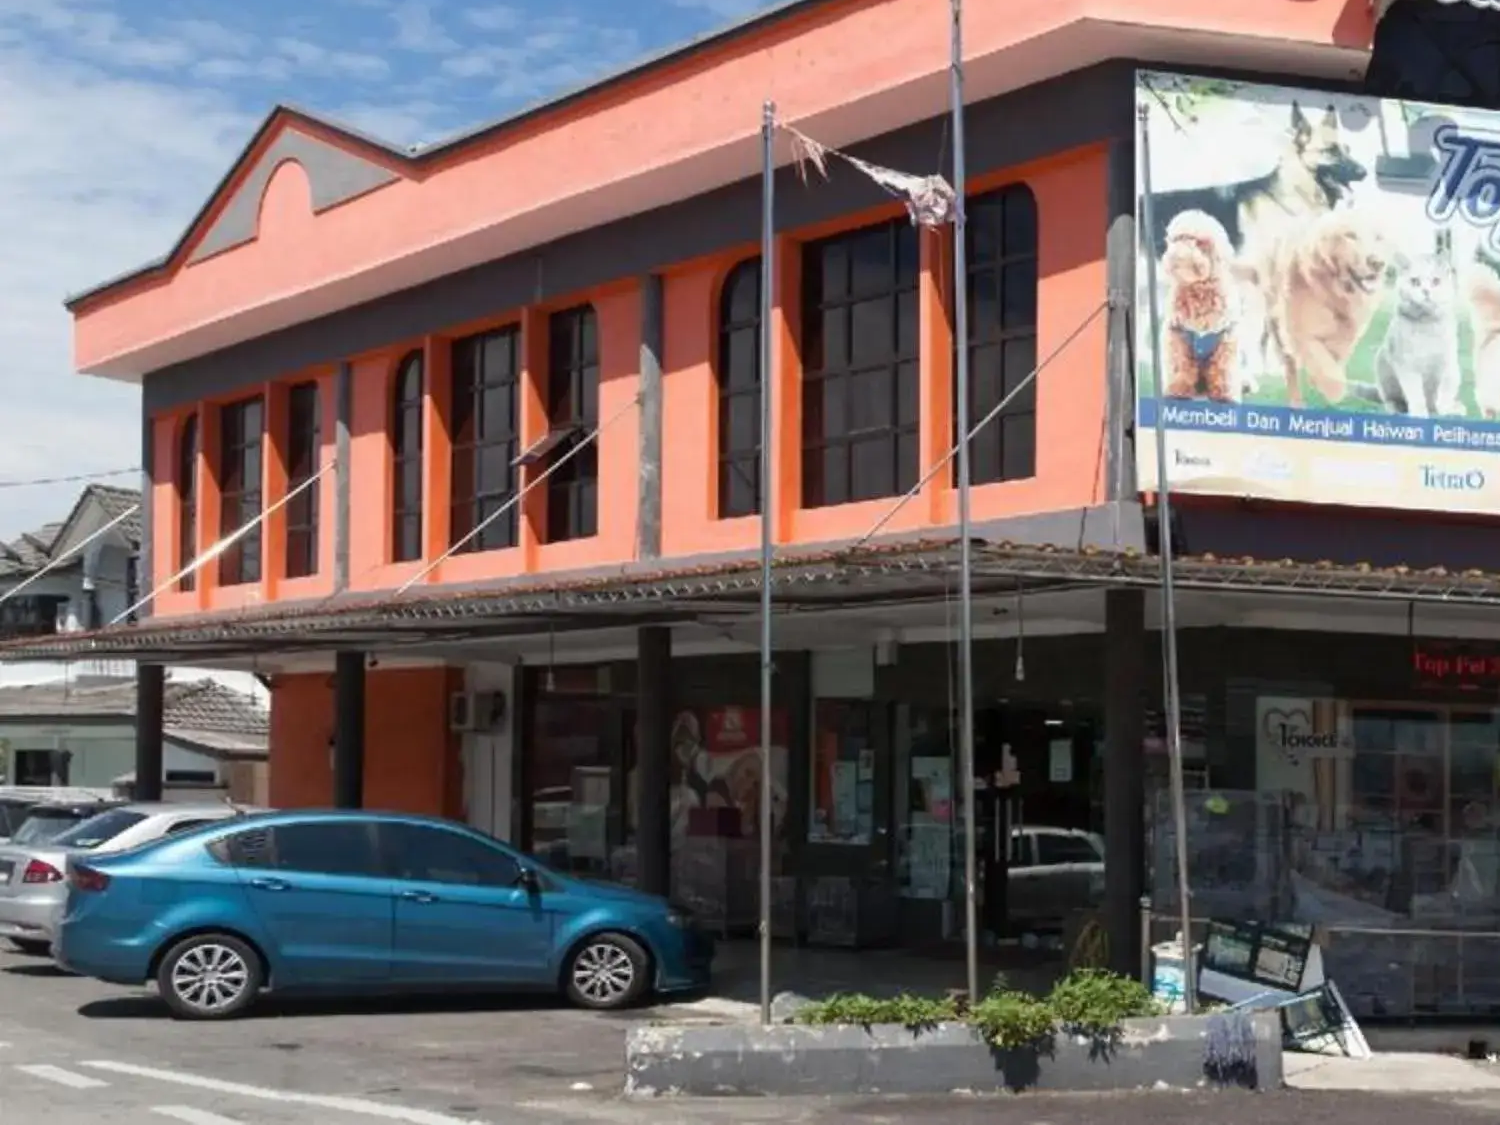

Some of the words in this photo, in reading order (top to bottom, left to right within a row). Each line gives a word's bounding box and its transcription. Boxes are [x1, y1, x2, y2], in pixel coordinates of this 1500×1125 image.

[1162, 406, 1237, 427] Membeli
[1247, 412, 1280, 431] Dan
[1289, 415, 1353, 437] Menjual
[1363, 420, 1424, 440] Haiwan
